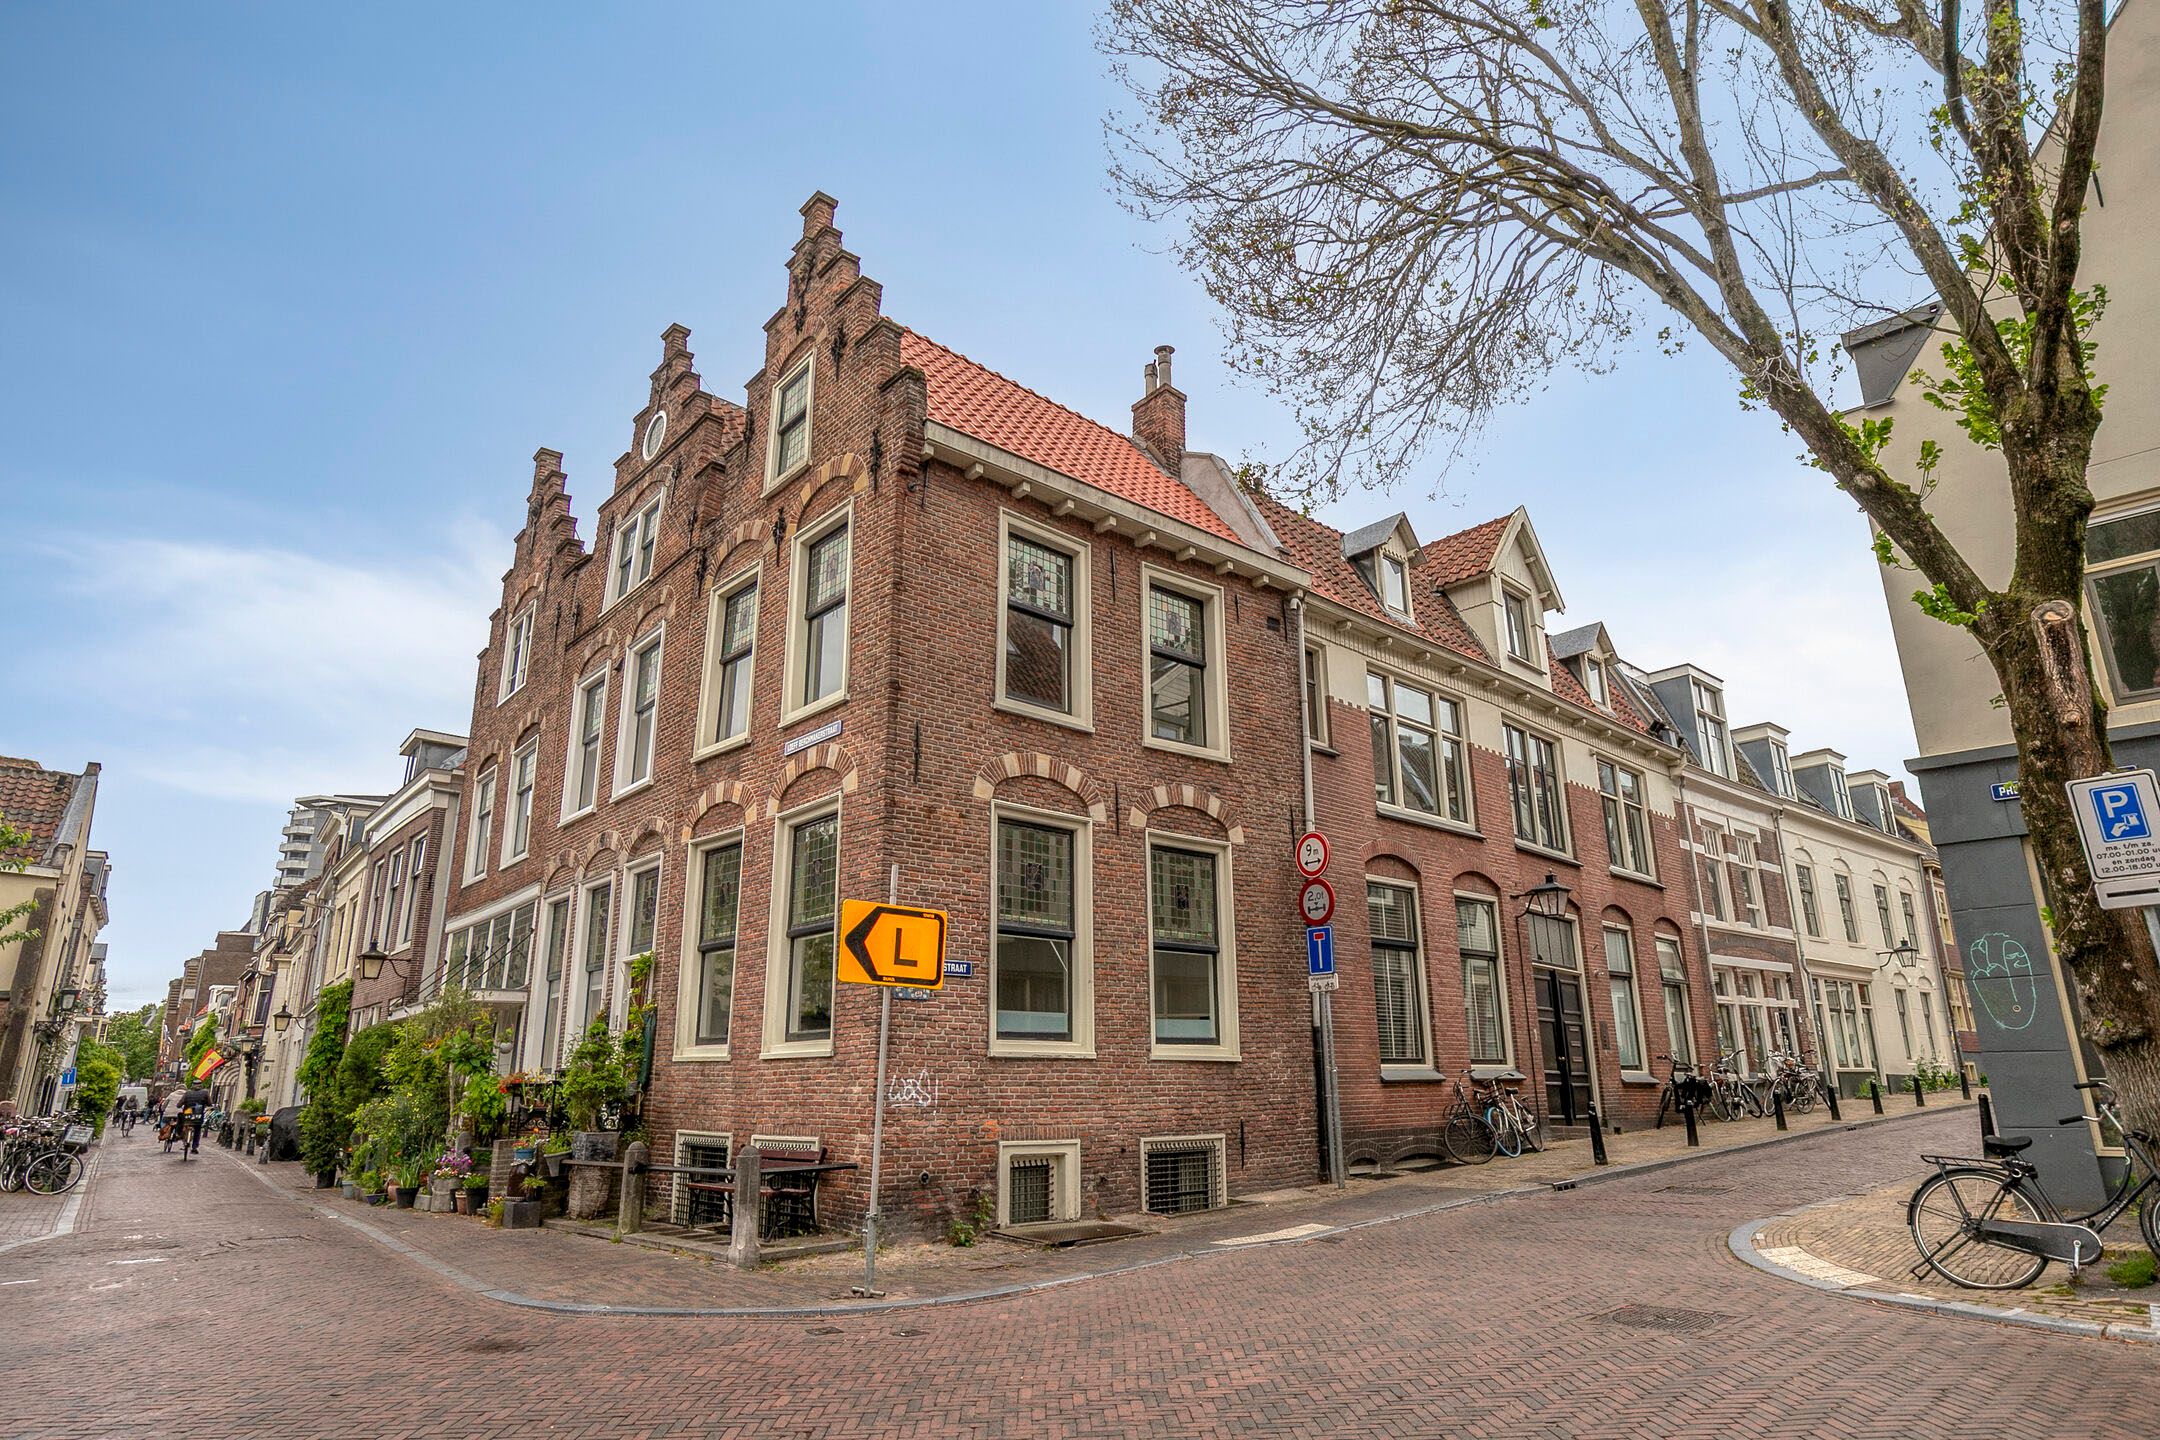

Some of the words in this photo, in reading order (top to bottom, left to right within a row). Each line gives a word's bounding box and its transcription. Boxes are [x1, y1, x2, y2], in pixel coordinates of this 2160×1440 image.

[2101, 790, 2128, 818] P
[2123, 842, 2139, 850] t/m
[2096, 848, 2150, 860] 07.00-01.00
[2125, 855, 2156, 864] zondag
[2101, 863, 2153, 874] 12.00-18.00
[893, 927, 918, 968] L
